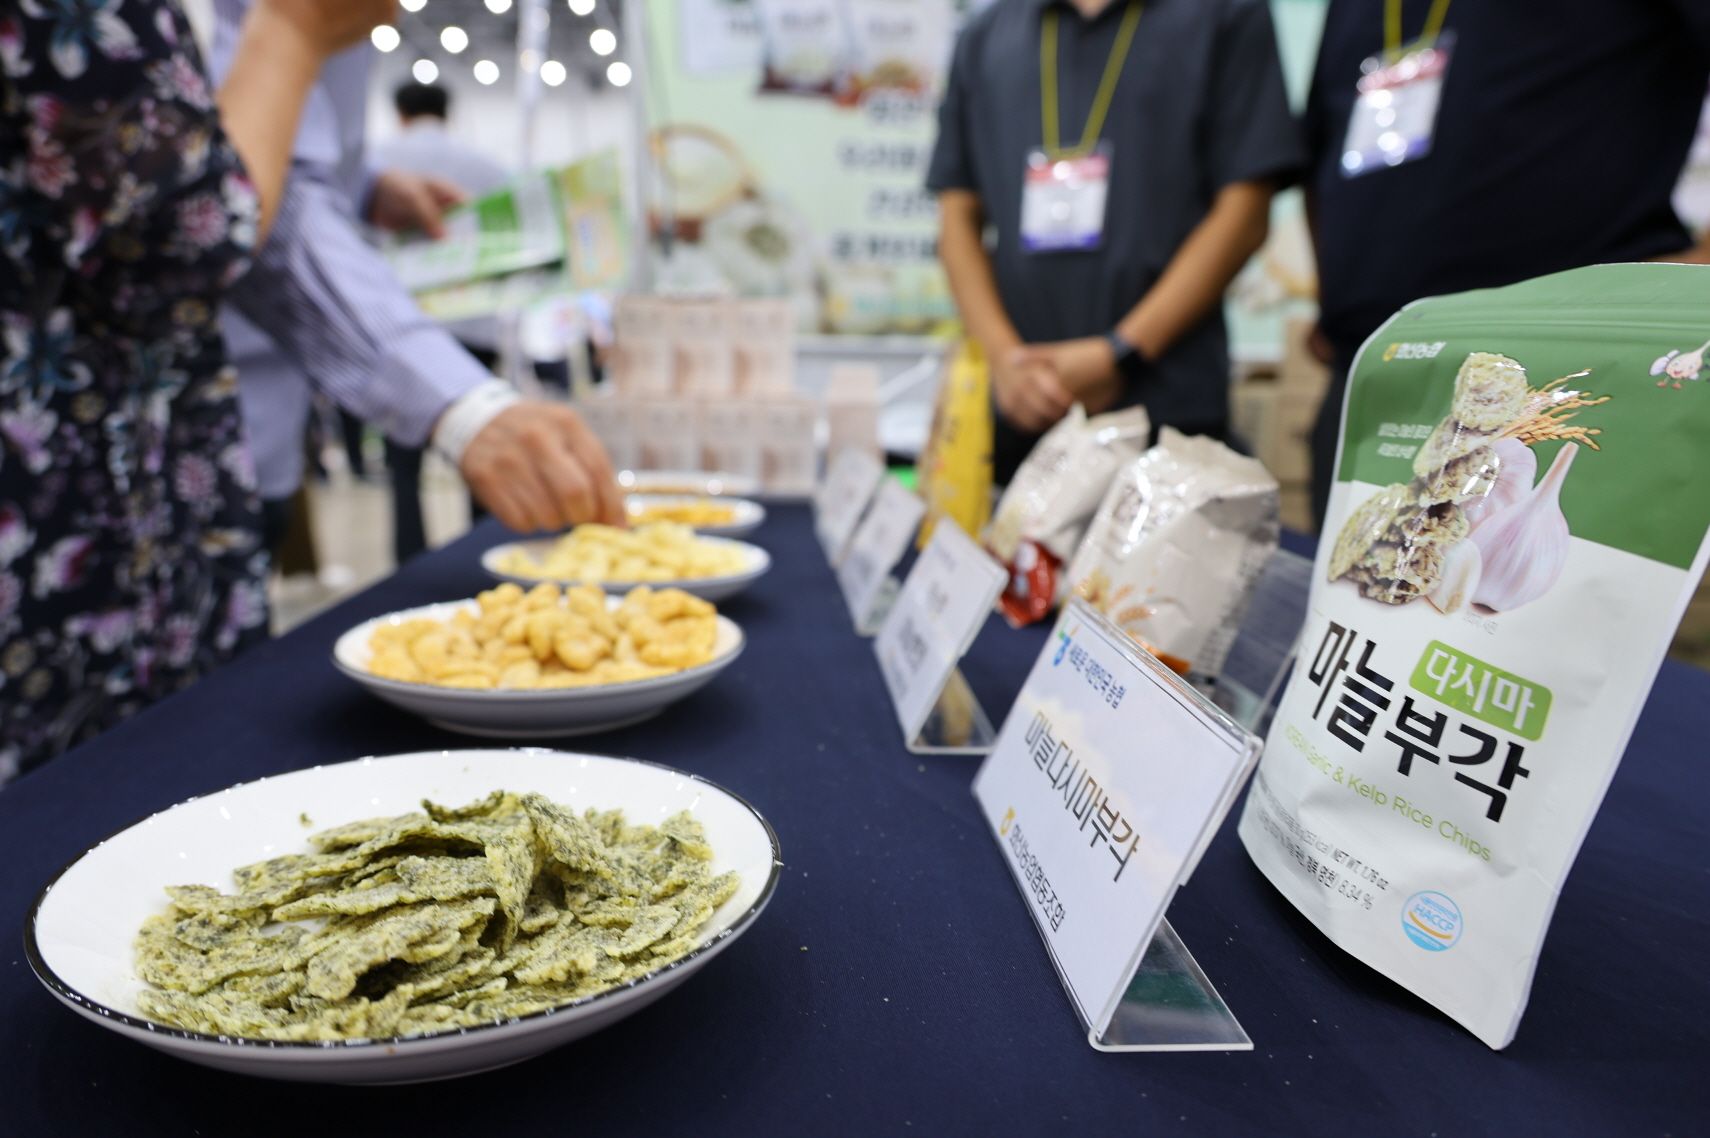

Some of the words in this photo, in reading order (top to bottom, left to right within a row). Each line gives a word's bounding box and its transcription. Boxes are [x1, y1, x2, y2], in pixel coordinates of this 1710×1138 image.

[1105, 679, 1127, 709] 농협
[1308, 620, 1531, 823] 마늘부각
[1426, 648, 1536, 730] 다시마
[1024, 710, 1141, 883] 마늘다시마부각
[1332, 766, 1344, 784] &
[1347, 774, 1388, 806] Kelp
[1392, 796, 1433, 829] Rice
[1439, 820, 1492, 863] Chips
[1414, 903, 1455, 931] HACCP
